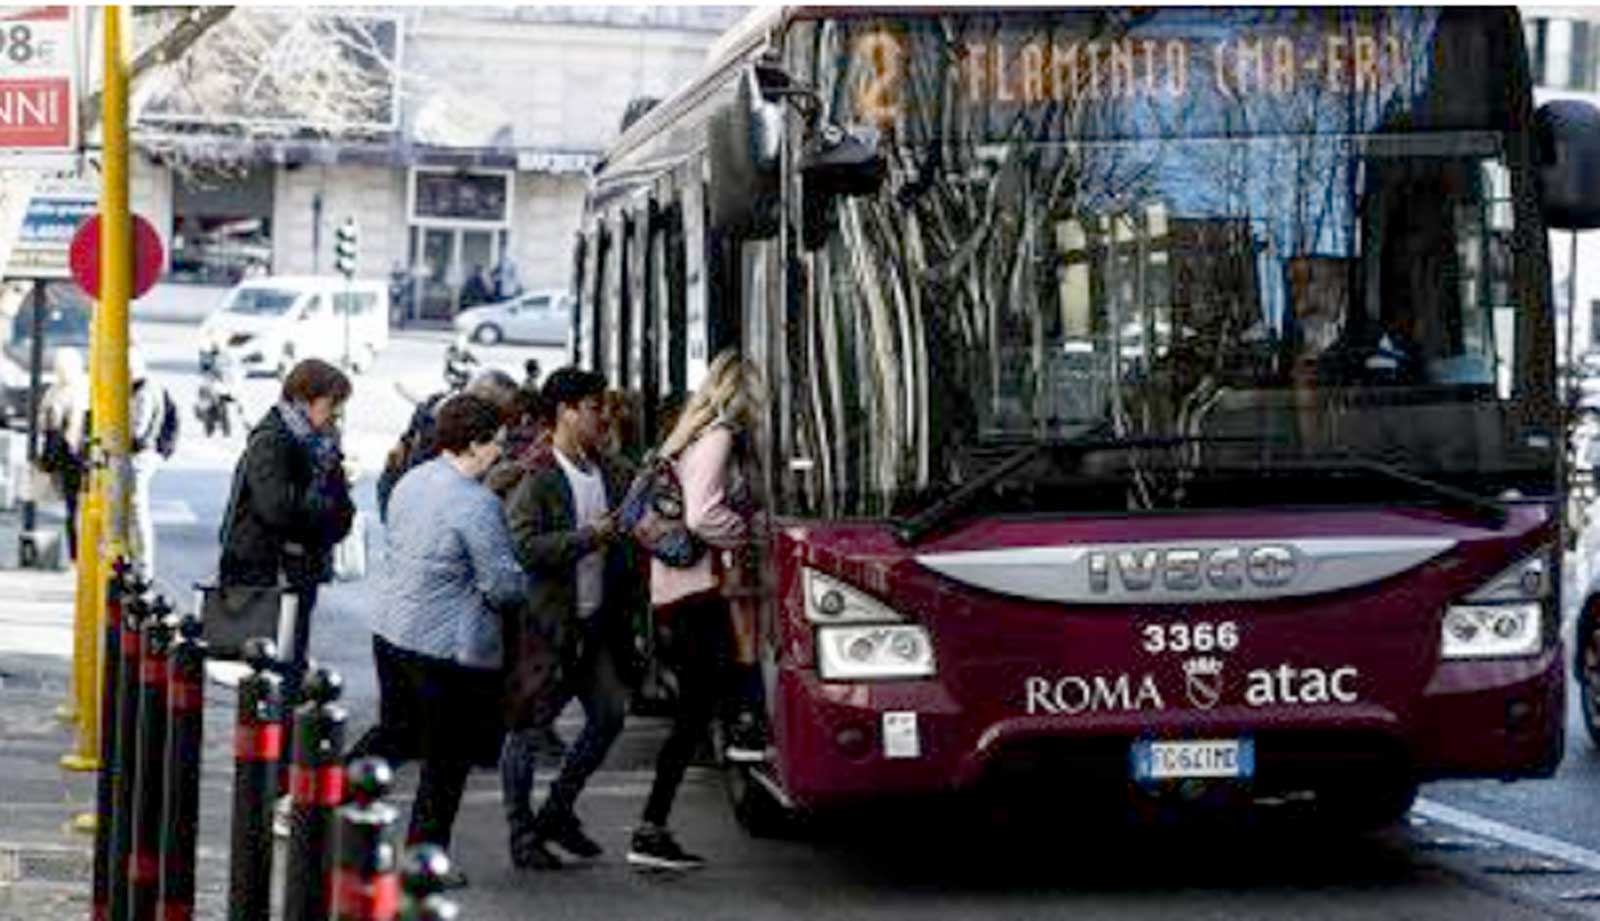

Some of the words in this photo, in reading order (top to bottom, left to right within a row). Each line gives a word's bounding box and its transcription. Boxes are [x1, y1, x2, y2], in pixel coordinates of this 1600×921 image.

[853, 33, 902, 120] 2
[1087, 544, 1297, 593] IVECO
[1142, 622, 1240, 653] 3366
[1025, 675, 1165, 714] ROMA
[1245, 661, 1358, 704] atac
